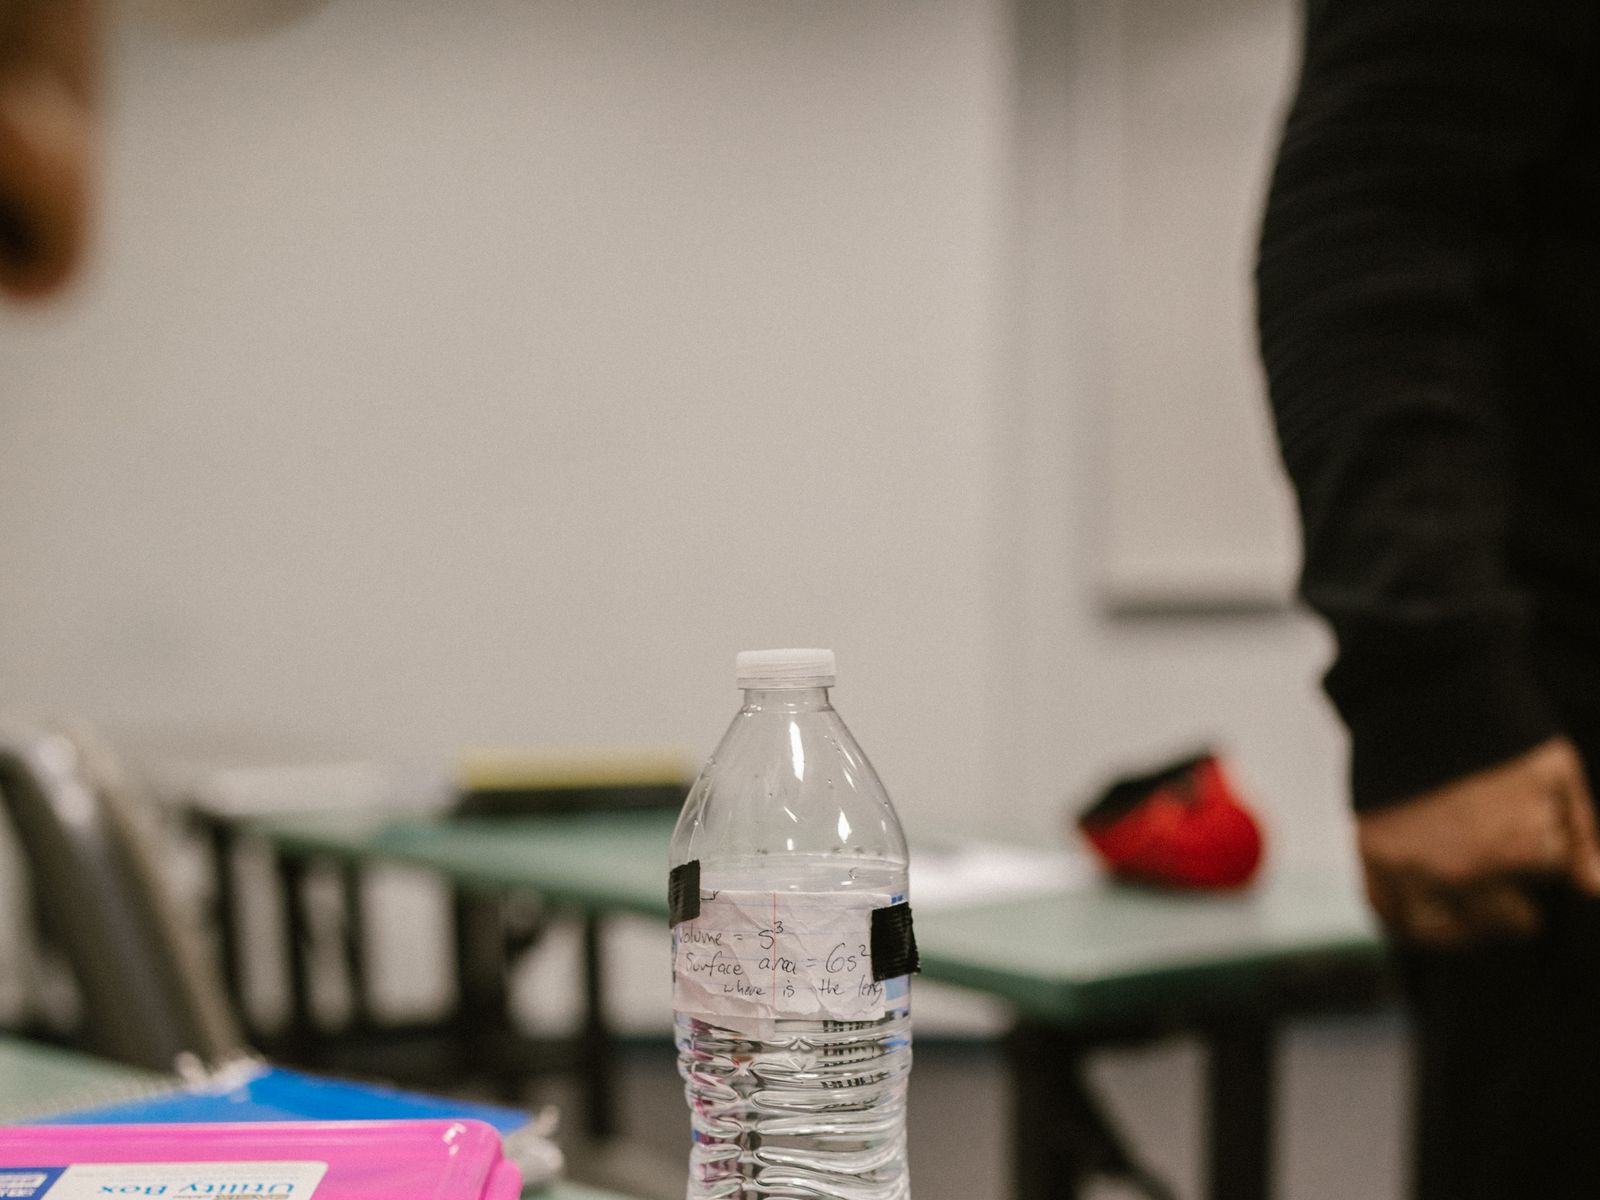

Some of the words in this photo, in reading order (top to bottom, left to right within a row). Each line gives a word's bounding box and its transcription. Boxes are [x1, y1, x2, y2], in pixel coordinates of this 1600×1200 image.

[686, 950, 743, 976] Surface
[783, 979, 795, 997] is
[818, 978, 846, 996] the
[97, 1185, 168, 1195] Box
[179, 1182, 294, 1194] Utility
